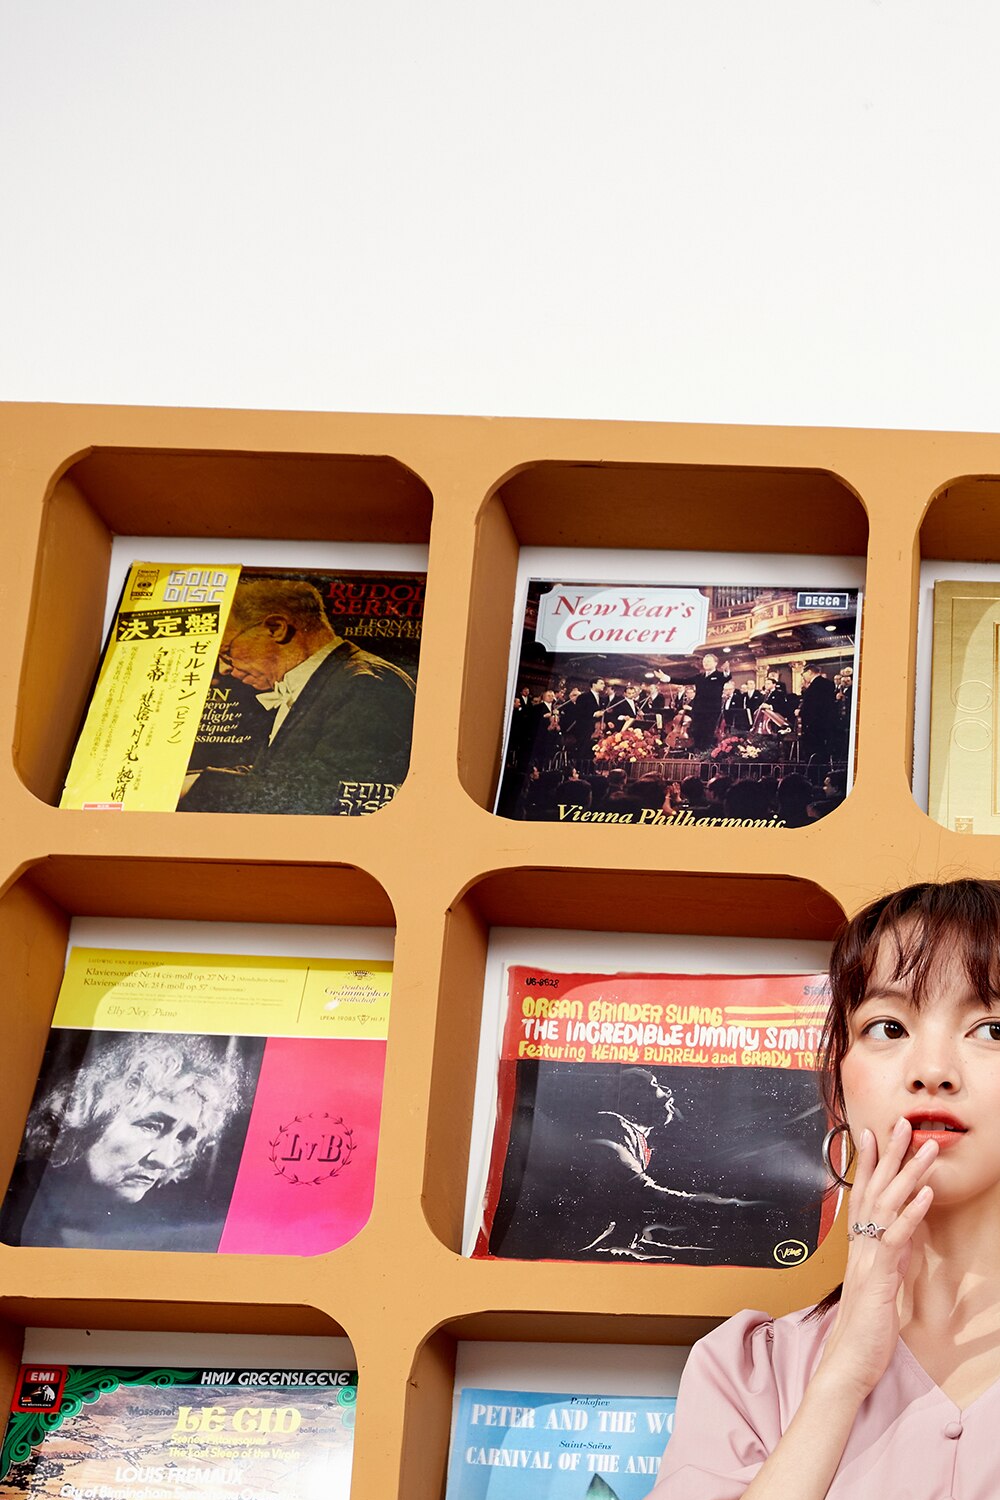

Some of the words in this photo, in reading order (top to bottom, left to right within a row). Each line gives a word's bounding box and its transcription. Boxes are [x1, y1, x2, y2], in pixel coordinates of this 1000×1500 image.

[168, 570, 229, 587] GOLD
[163, 587, 225, 603] DISC
[804, 596, 840, 607] DECCA
[551, 595, 616, 618] New
[616, 596, 695, 619] Year's
[118, 613, 218, 641] 決定盤
[566, 619, 677, 643] Concert
[557, 803, 633, 824] Vienna
[636, 807, 787, 829] Philharmonic
[83, 978, 135, 988] Klaviersonate
[86, 968, 138, 978] Klaviersonate
[107, 1006, 124, 1017] Elly
[153, 1007, 178, 1018] Piano
[521, 996, 583, 1020] ORGAN
[588, 1000, 665, 1025] GRINDER
[665, 1004, 724, 1026] SWING
[522, 1018, 560, 1041] THE
[566, 1020, 683, 1048] INCREDIBLE
[518, 1039, 586, 1062] Featuring
[644, 1047, 709, 1066] BURRELL
[711, 1051, 738, 1066] and
[741, 1049, 791, 1069] GRADY
[30, 1371, 56, 1382] EMI
[200, 1371, 236, 1386] HMV
[237, 1371, 350, 1387] GREENSLEEVE
[570, 1396, 611, 1408] Prokofiev
[173, 1406, 227, 1433] LE
[232, 1407, 302, 1434] CID
[470, 1403, 536, 1429] PETER
[544, 1408, 589, 1432] AND
[598, 1410, 637, 1434] THE
[558, 1439, 613, 1450] Saint-Saëns
[466, 1446, 553, 1470] CARNIVAL
[558, 1452, 581, 1471] OF
[587, 1453, 620, 1473] THE
